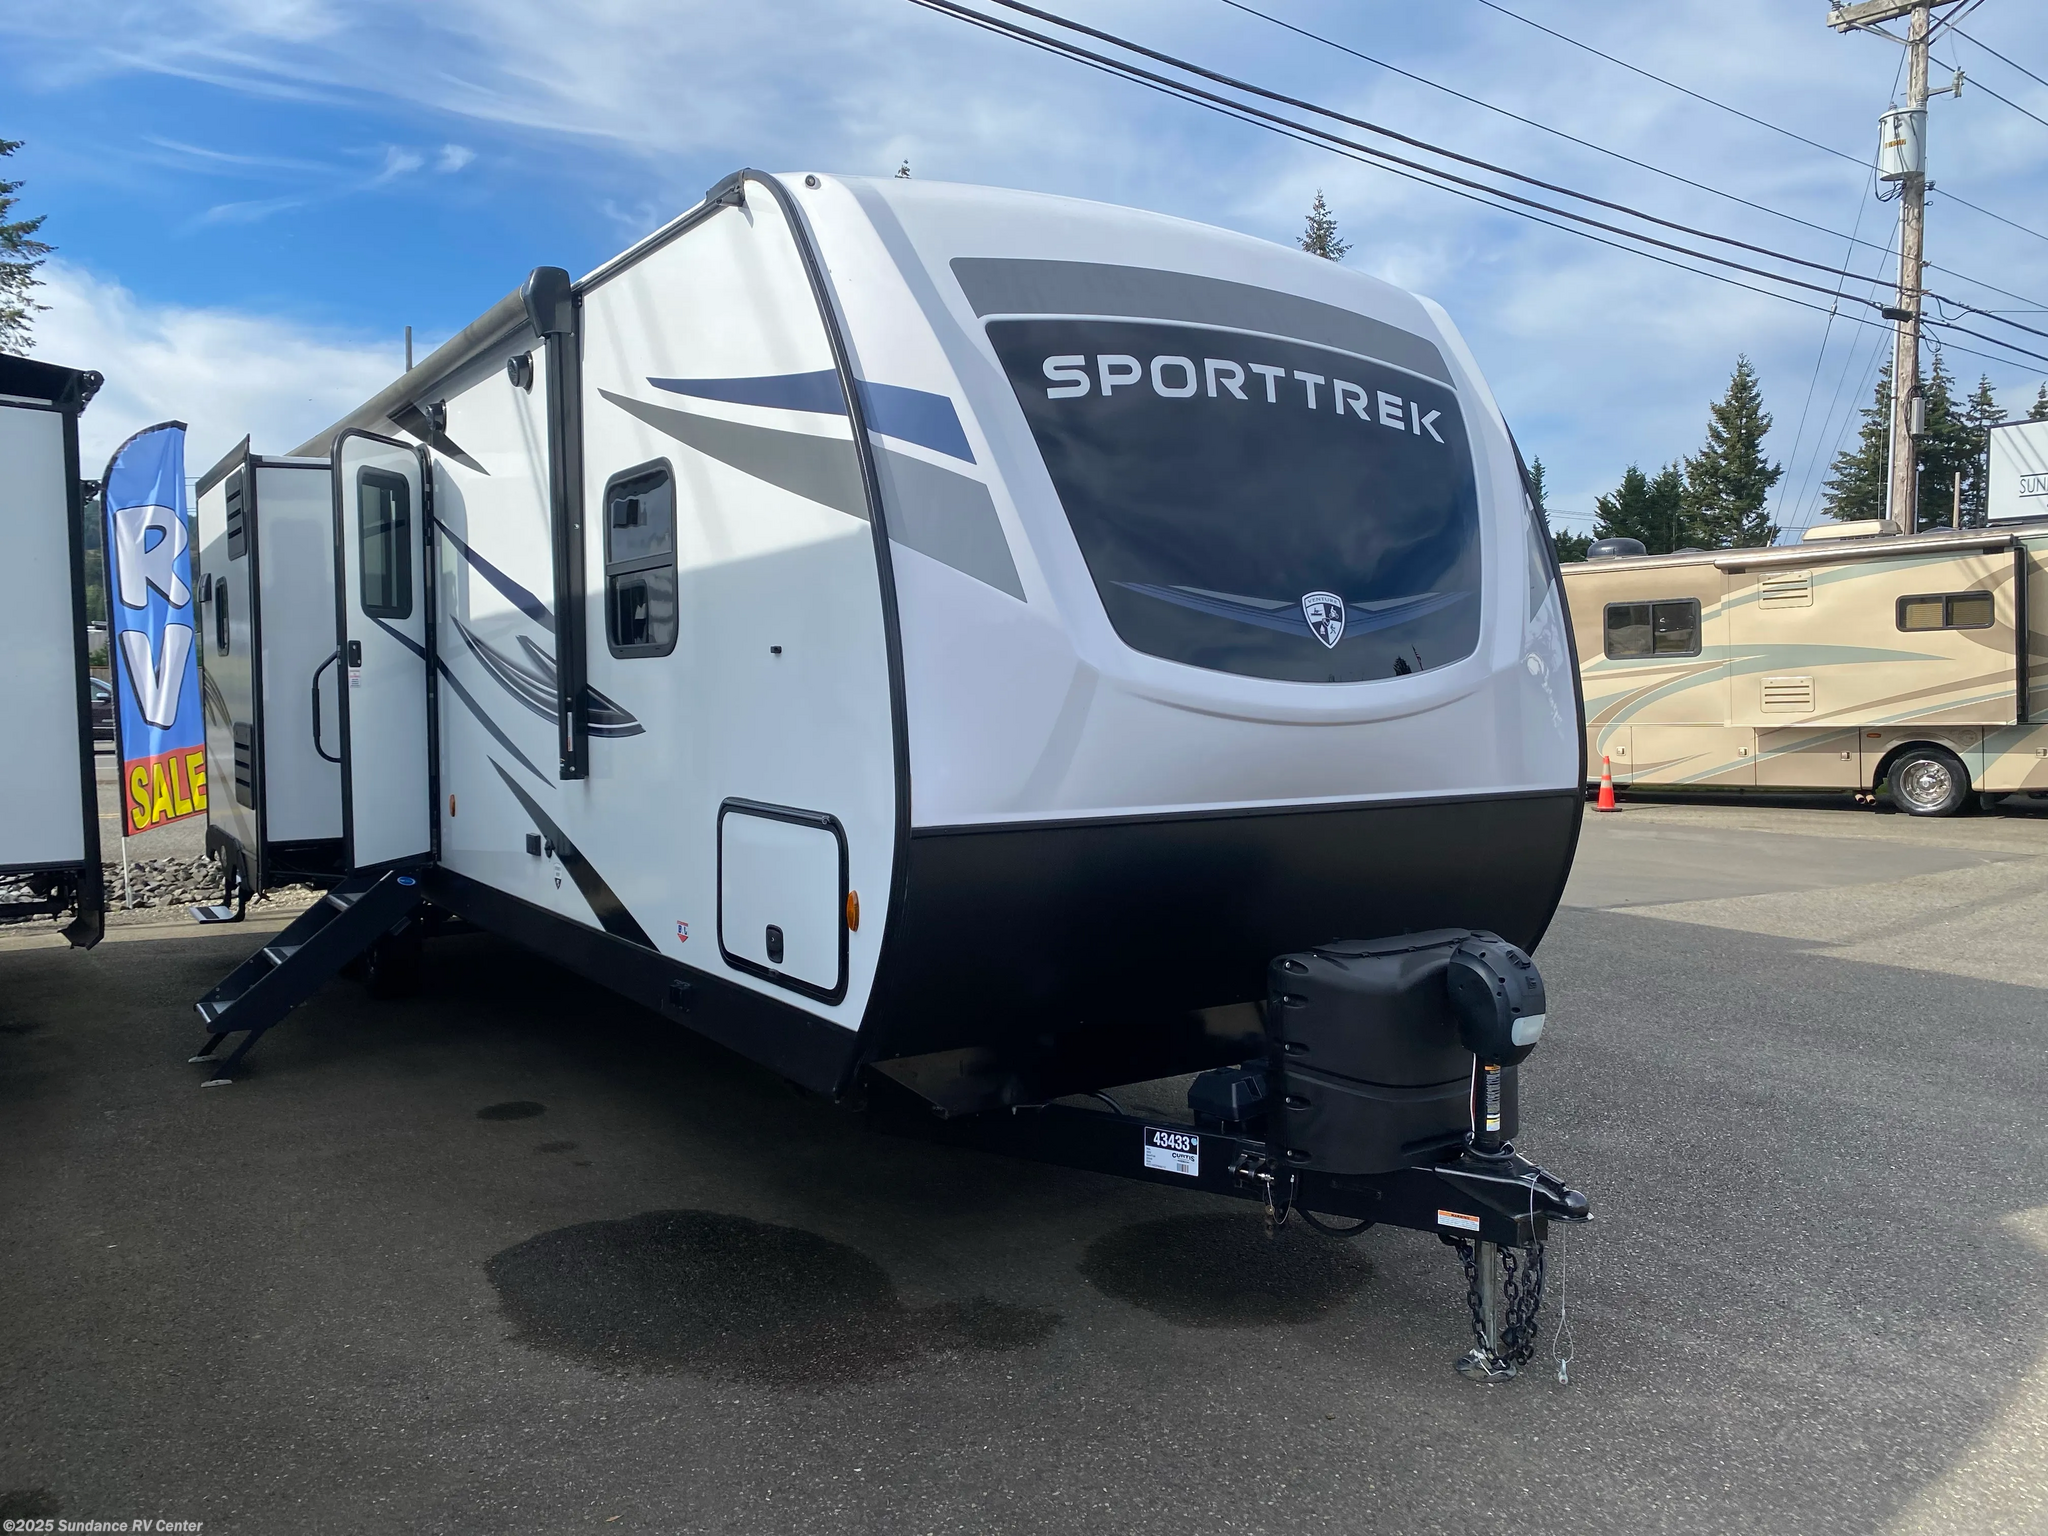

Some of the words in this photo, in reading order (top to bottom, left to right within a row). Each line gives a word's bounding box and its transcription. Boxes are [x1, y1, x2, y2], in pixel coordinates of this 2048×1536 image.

[1042, 354, 1445, 444] SPORTTREK
[2019, 476, 2048, 494] SUN
[114, 504, 194, 730] RV
[1307, 596, 1339, 604] VENTURE
[129, 750, 207, 831] SALE
[1153, 1131, 1190, 1151] 43433
